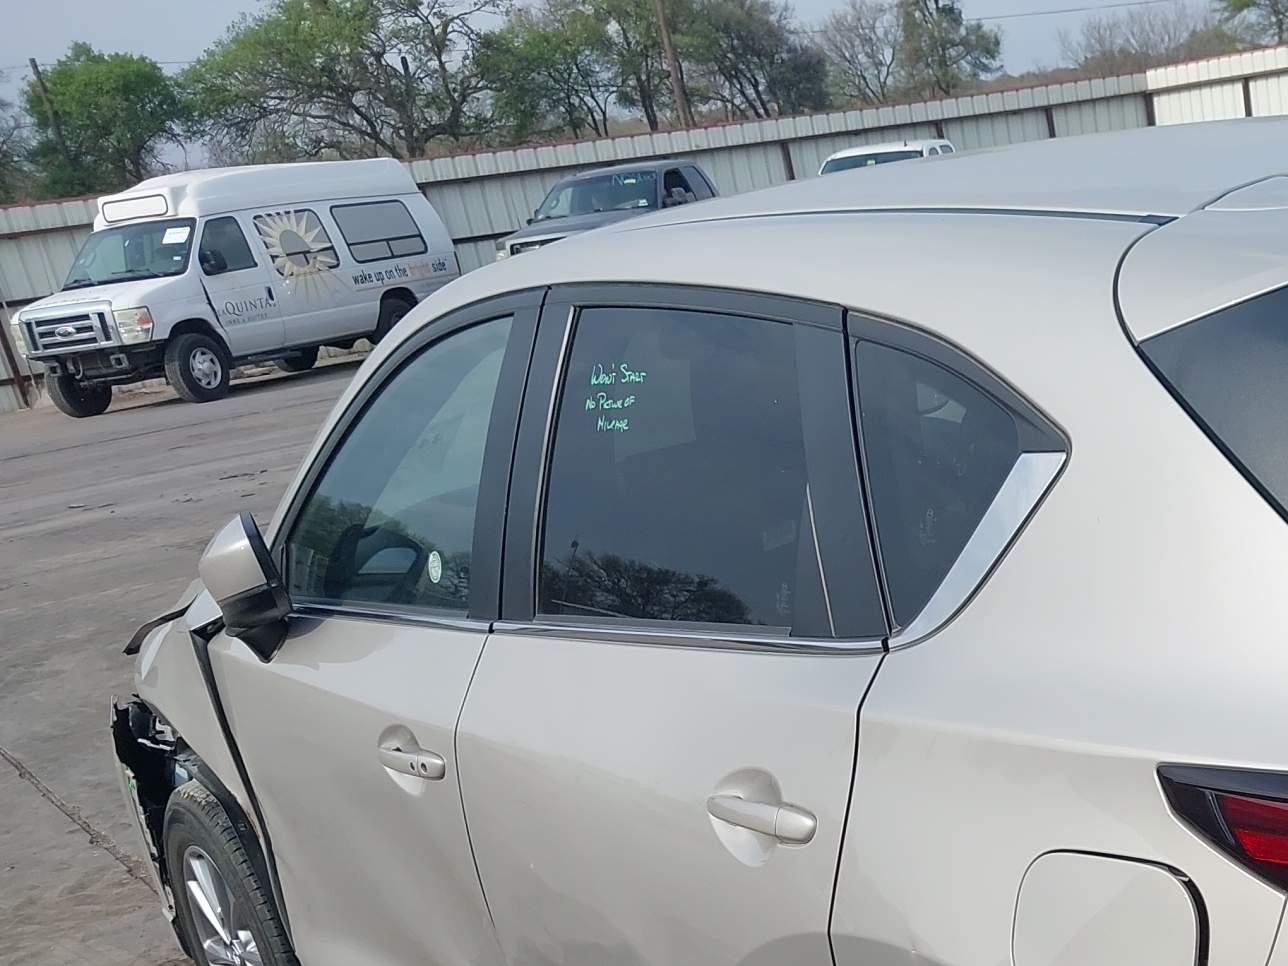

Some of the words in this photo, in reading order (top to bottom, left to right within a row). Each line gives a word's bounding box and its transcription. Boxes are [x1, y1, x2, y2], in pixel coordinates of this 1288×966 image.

[352, 269, 373, 286] wake
[374, 271, 384, 286] up
[385, 269, 395, 280] on
[395, 264, 409, 279] the
[431, 258, 447, 273] side
[225, 297, 272, 316] QUINTA
